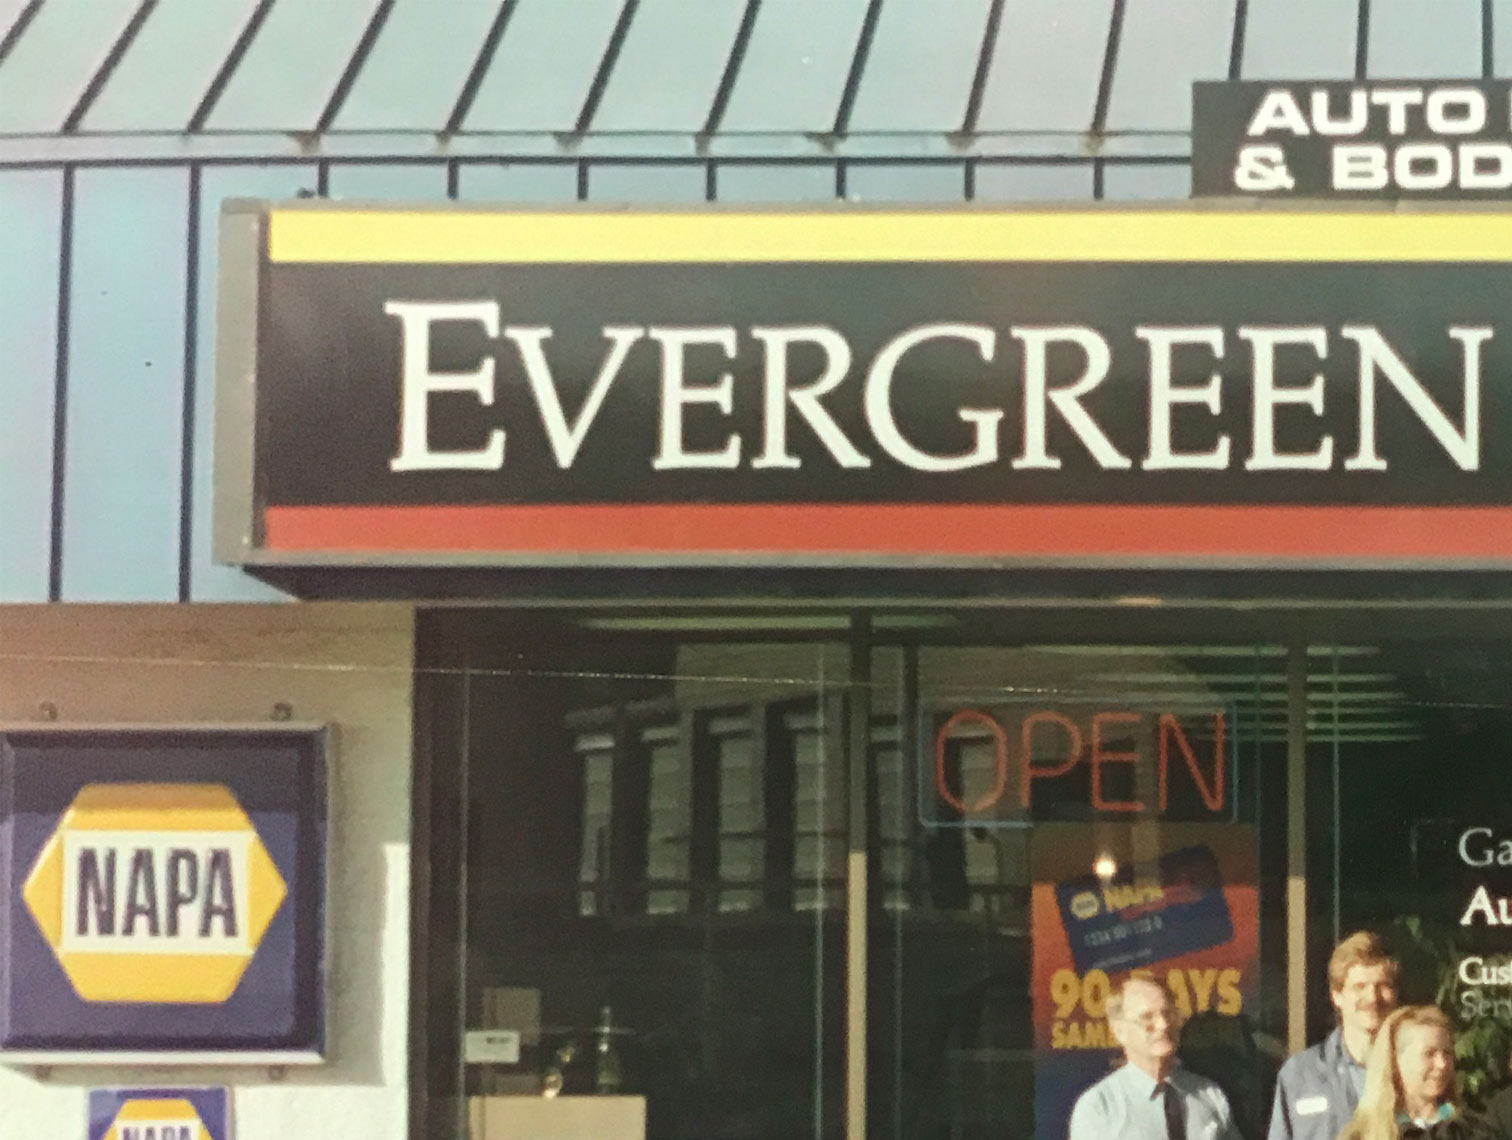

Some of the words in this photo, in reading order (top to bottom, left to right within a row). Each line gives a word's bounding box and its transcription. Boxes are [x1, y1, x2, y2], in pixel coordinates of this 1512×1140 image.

[1247, 88, 1487, 136] AUTO
[1233, 146, 1295, 192] &
[383, 298, 1494, 473] EVERGREEN
[933, 708, 1226, 813] OPEN
[75, 846, 240, 939] NAPA
[1050, 968, 1110, 1018] 90
[1129, 968, 1243, 1018] AYS
